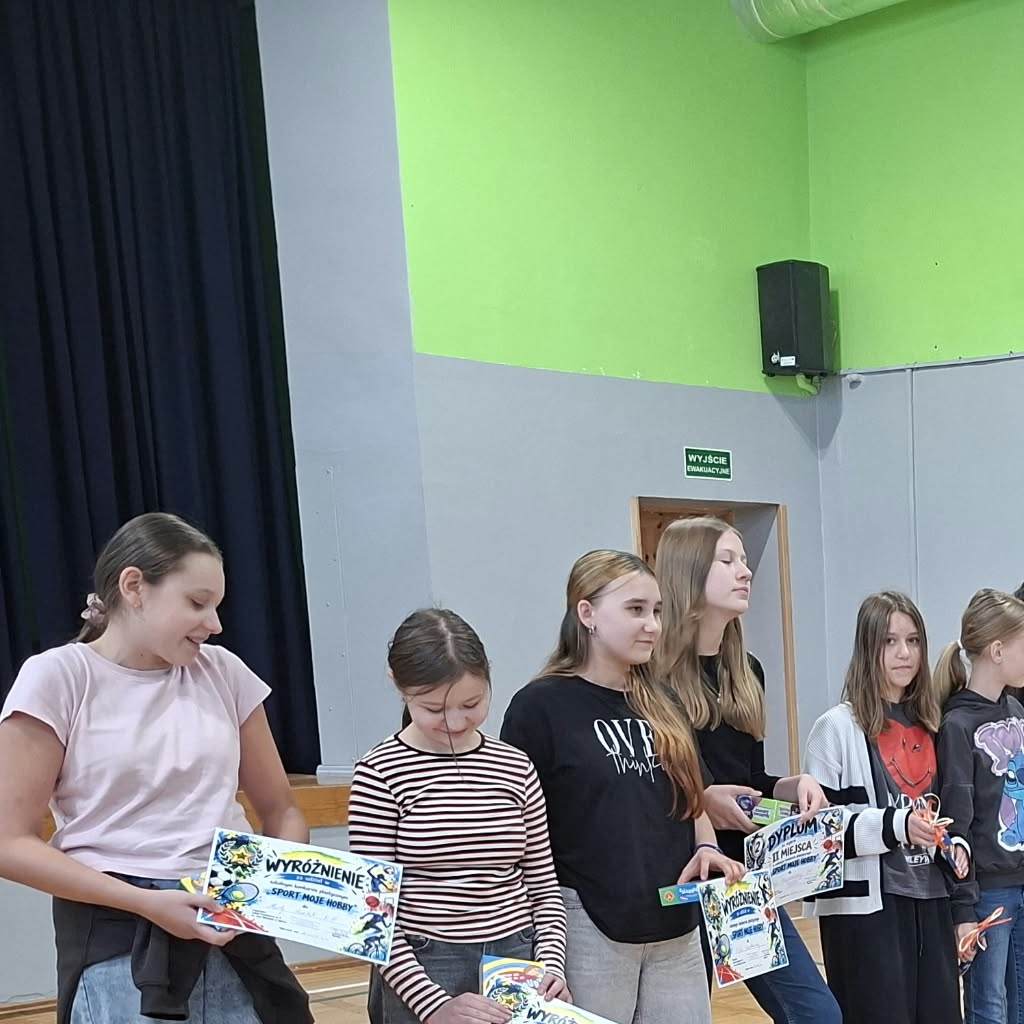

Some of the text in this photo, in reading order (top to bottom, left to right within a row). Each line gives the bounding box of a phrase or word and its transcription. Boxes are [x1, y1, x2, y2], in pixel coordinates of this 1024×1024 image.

[688, 454, 728, 465] WYJŚCIE
[687, 465, 730, 475] EWAKUACYJNE
[780, 840, 812, 859] MIEJSCA
[265, 858, 366, 890] WYRÓŻNIENIE
[302, 893, 325, 905] MOJE
